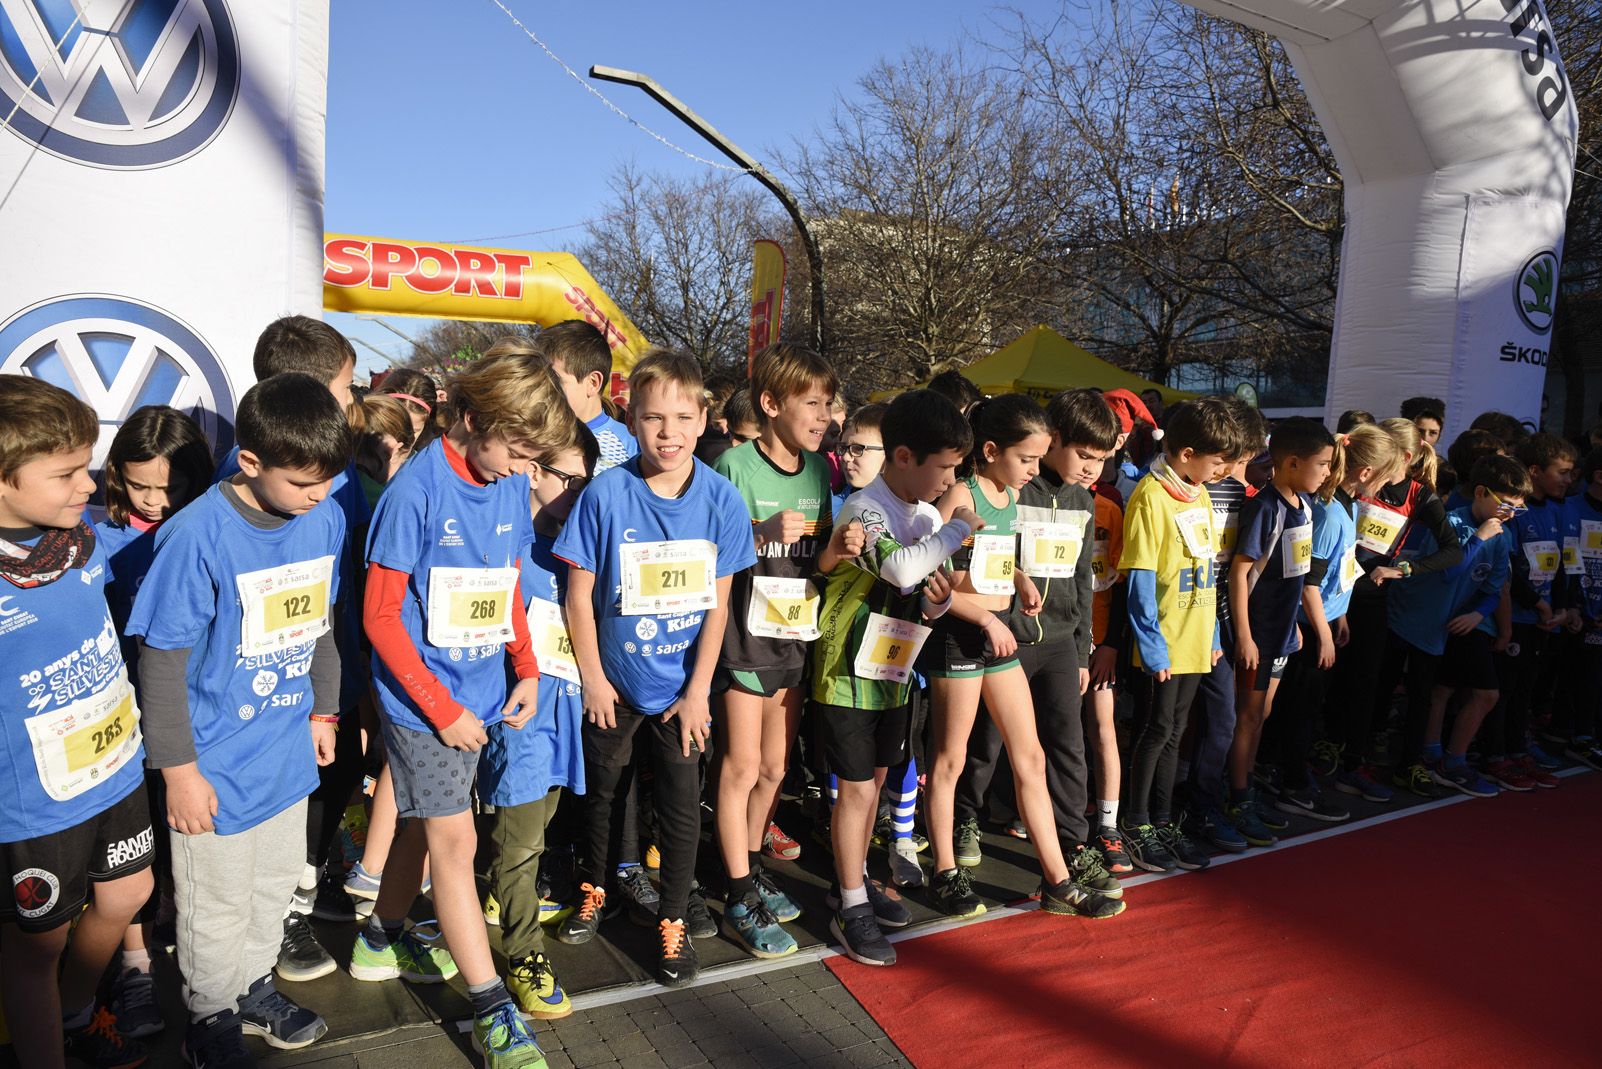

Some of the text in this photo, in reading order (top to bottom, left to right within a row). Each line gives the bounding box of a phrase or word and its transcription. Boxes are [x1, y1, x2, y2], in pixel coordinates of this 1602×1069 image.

[323, 239, 533, 301] SPORT
[1367, 523, 1388, 538] 234
[1054, 546, 1065, 559] 72
[1002, 561, 1012, 575] 59
[1091, 560, 1104, 575] 63
[661, 569, 686, 588] 271
[283, 594, 311, 619] 122
[470, 599, 496, 619] 268
[787, 605, 801, 621] 88
[667, 614, 701, 632] Kids
[656, 639, 690, 654] sarsa
[19, 638, 95, 688] 20 anys de
[50, 646, 99, 691] SANT
[91, 716, 123, 754] 283
[14, 869, 59, 890] HOQUEI CLUB
[28, 901, 55, 918] CUGAT
